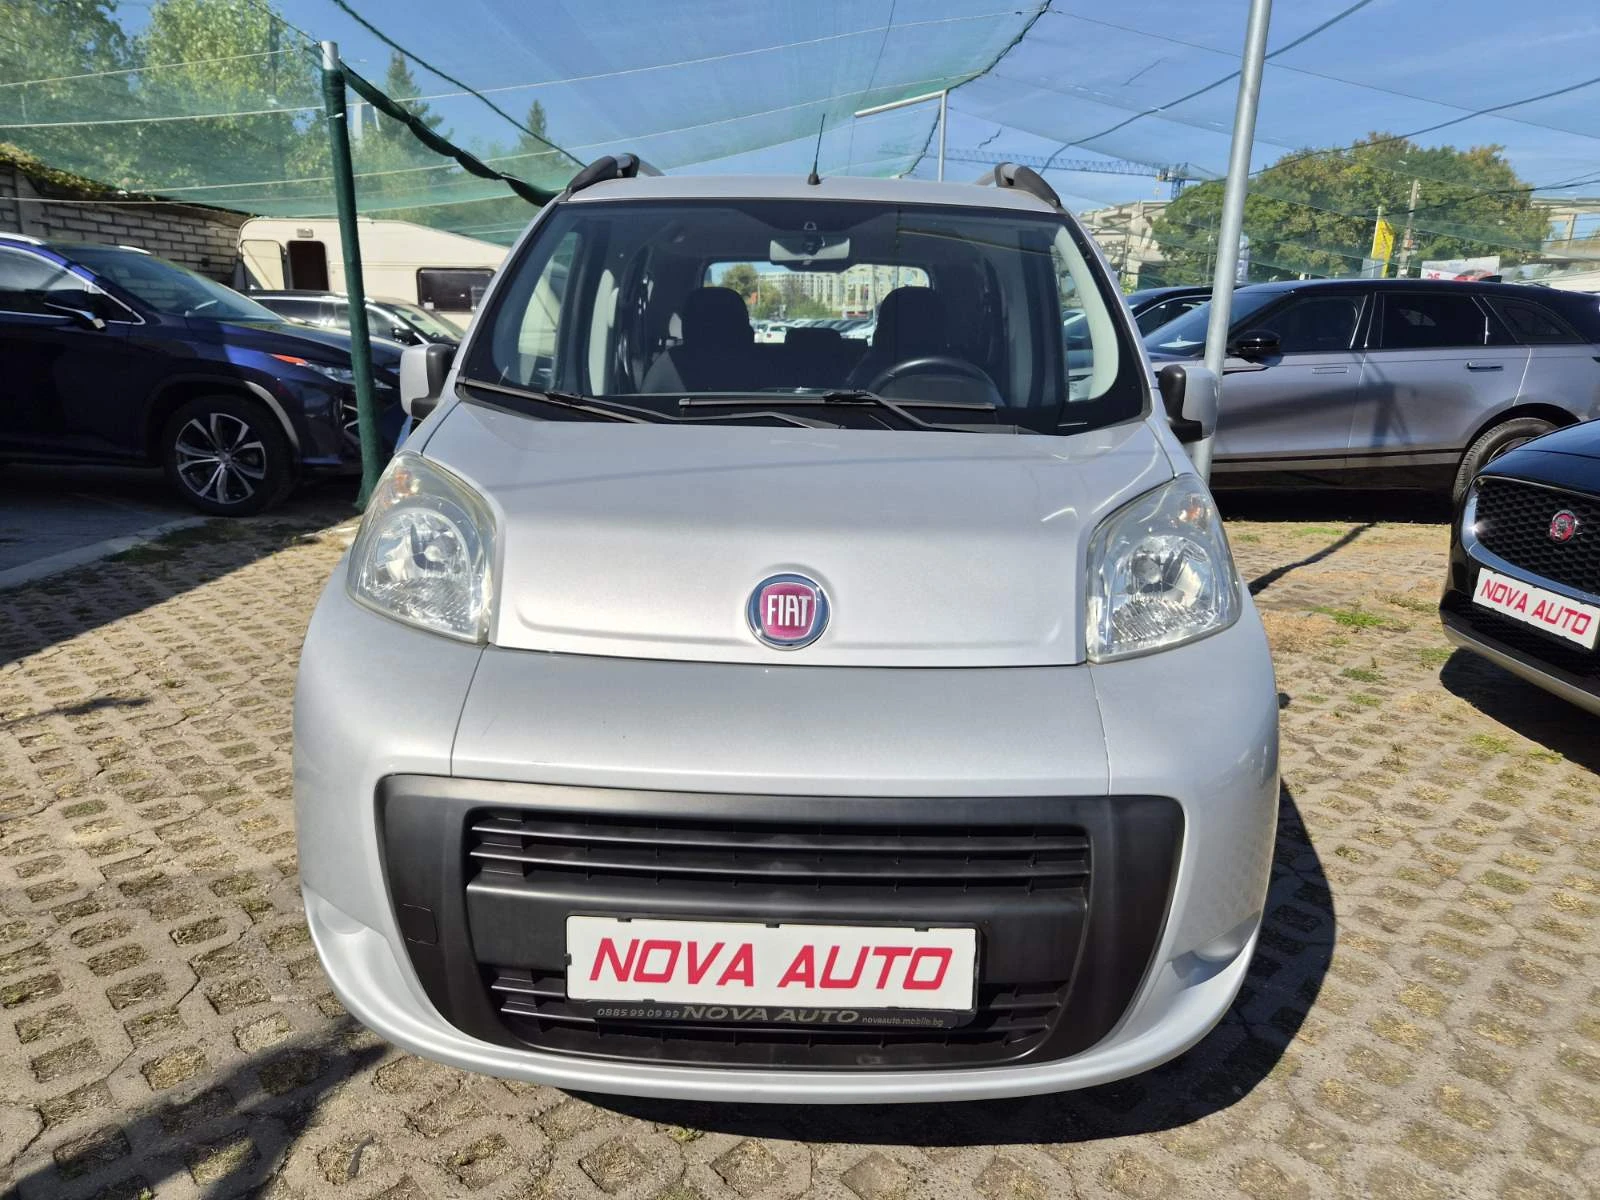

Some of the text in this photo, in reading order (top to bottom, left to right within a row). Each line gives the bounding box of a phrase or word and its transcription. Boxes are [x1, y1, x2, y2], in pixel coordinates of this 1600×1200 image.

[767, 594, 811, 627] FIAT
[1481, 579, 1592, 636] NOVA AUTO
[589, 937, 954, 992] NOVA AUTO
[596, 1008, 628, 1018] 0885
[630, 1009, 645, 1018] 99
[647, 1009, 662, 1018] 09
[664, 1010, 680, 1019] 99
[682, 1006, 769, 1021] NOVA
[773, 1008, 859, 1023] AUTO
